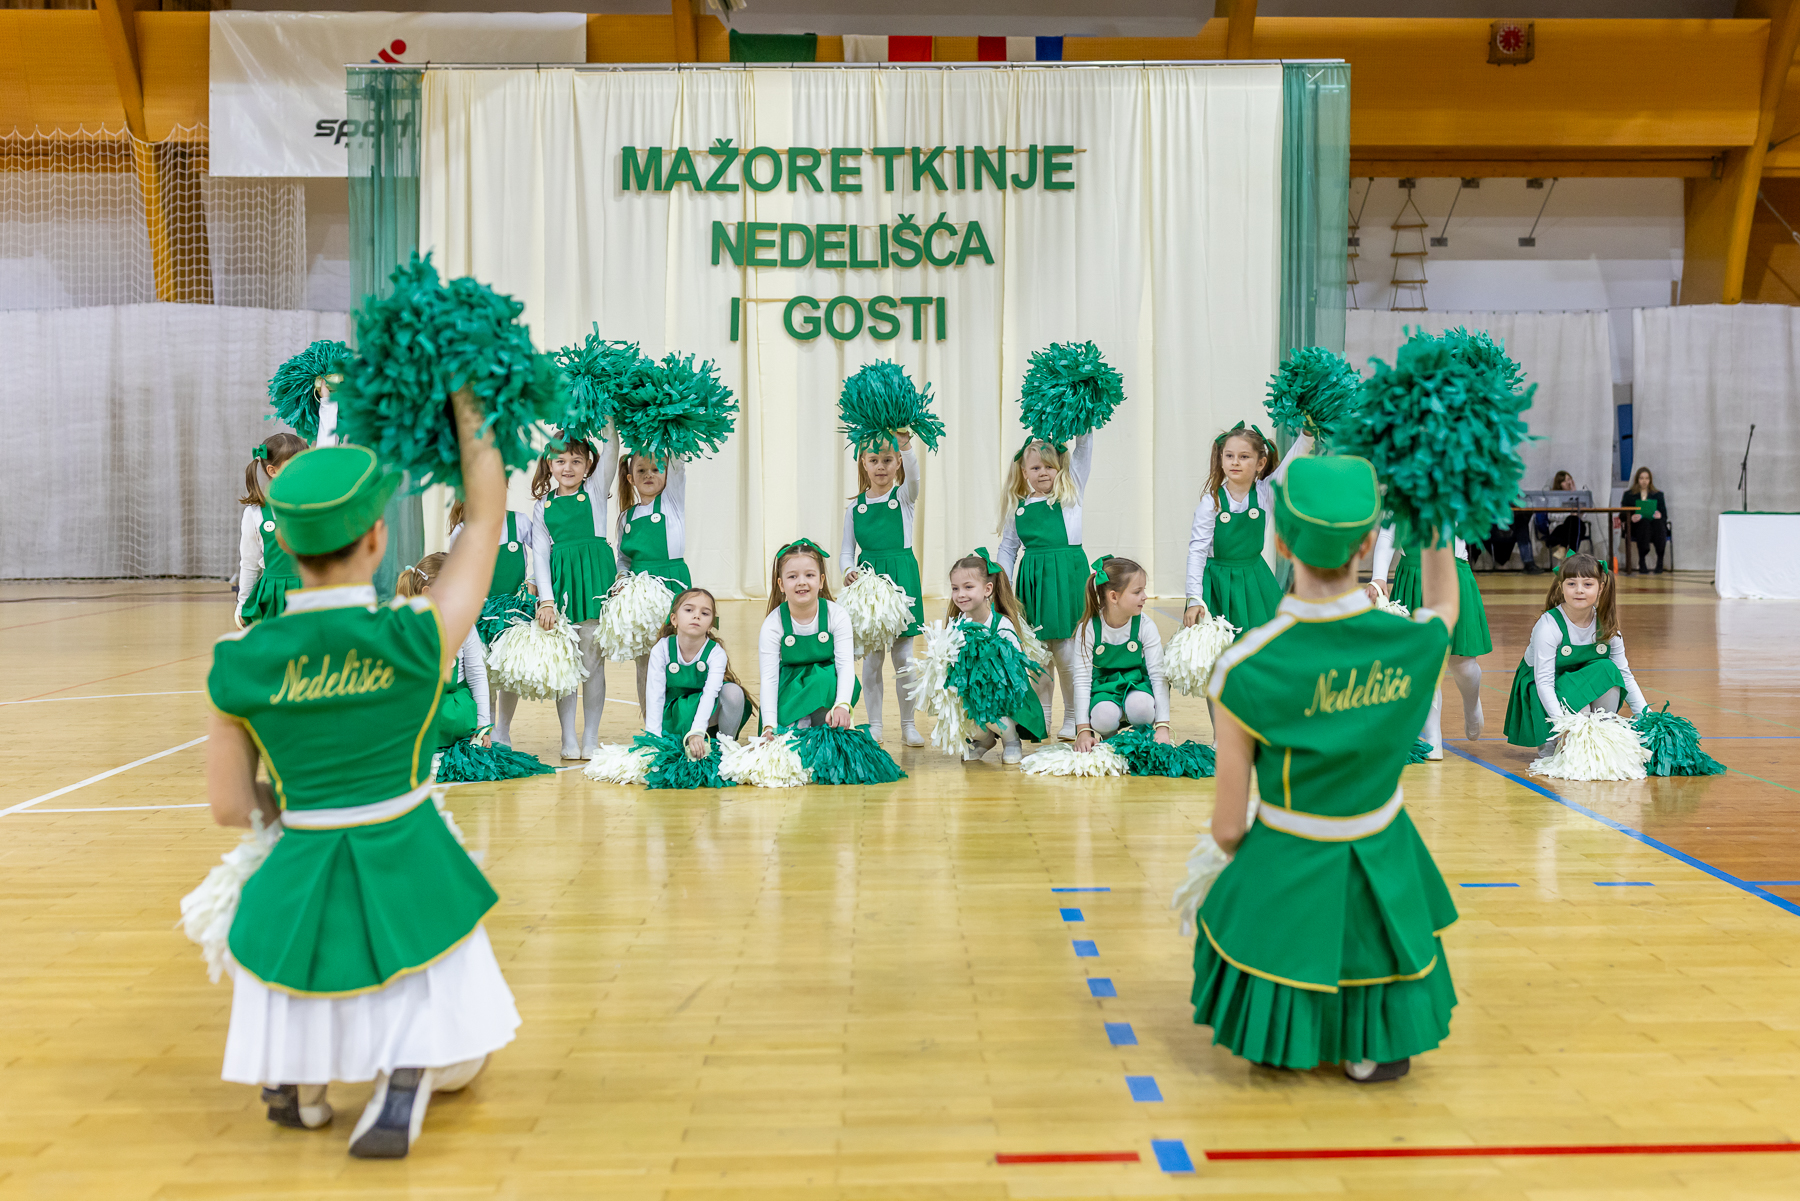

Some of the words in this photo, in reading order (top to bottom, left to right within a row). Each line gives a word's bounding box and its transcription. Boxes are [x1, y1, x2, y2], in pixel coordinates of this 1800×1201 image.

[621, 138, 1076, 192] MAŽORETKINJE
[711, 212, 995, 268] NEDELIŠĆA
[730, 297, 741, 341] I
[783, 295, 946, 341] GOSTI
